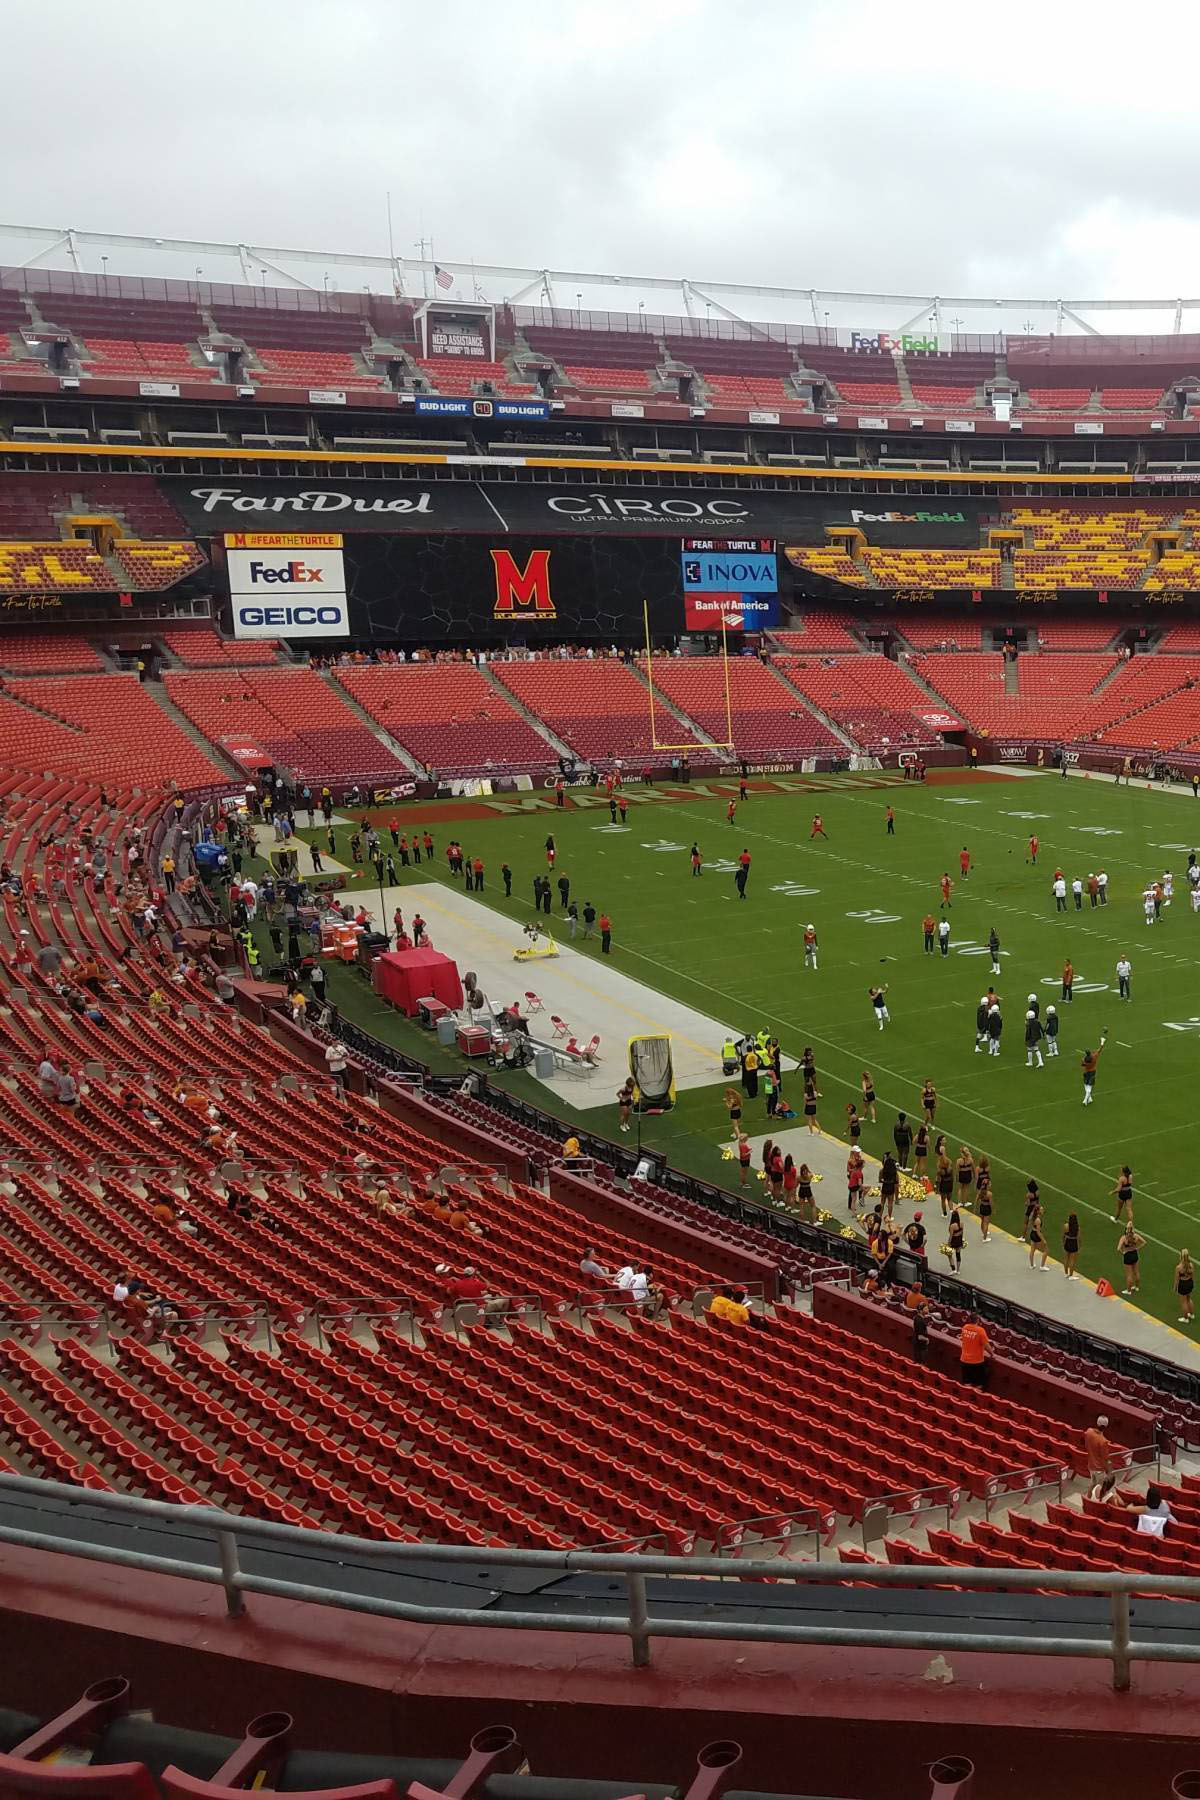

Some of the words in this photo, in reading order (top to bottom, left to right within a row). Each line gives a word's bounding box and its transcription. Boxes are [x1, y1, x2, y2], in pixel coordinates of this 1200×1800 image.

[851, 333, 939, 351] FedExField
[419, 402, 438, 411] BUD
[440, 403, 467, 412] LIGHT
[499, 406, 517, 415] BUD
[519, 407, 544, 416] LIGHT
[190, 488, 435, 513] FanDuel
[548, 493, 750, 517] CÎROC
[622, 515, 692, 524] PREMIUM
[851, 510, 965, 523] FedExField
[250, 562, 325, 583] FedEx
[490, 550, 556, 610] M
[708, 563, 774, 582] INOVA
[695, 600, 719, 611] Bank
[720, 600, 729, 611] of
[730, 601, 769, 611] America
[239, 607, 342, 626] GEICO
[1065, 751, 1080, 763] 937
[845, 909, 903, 924] 50
